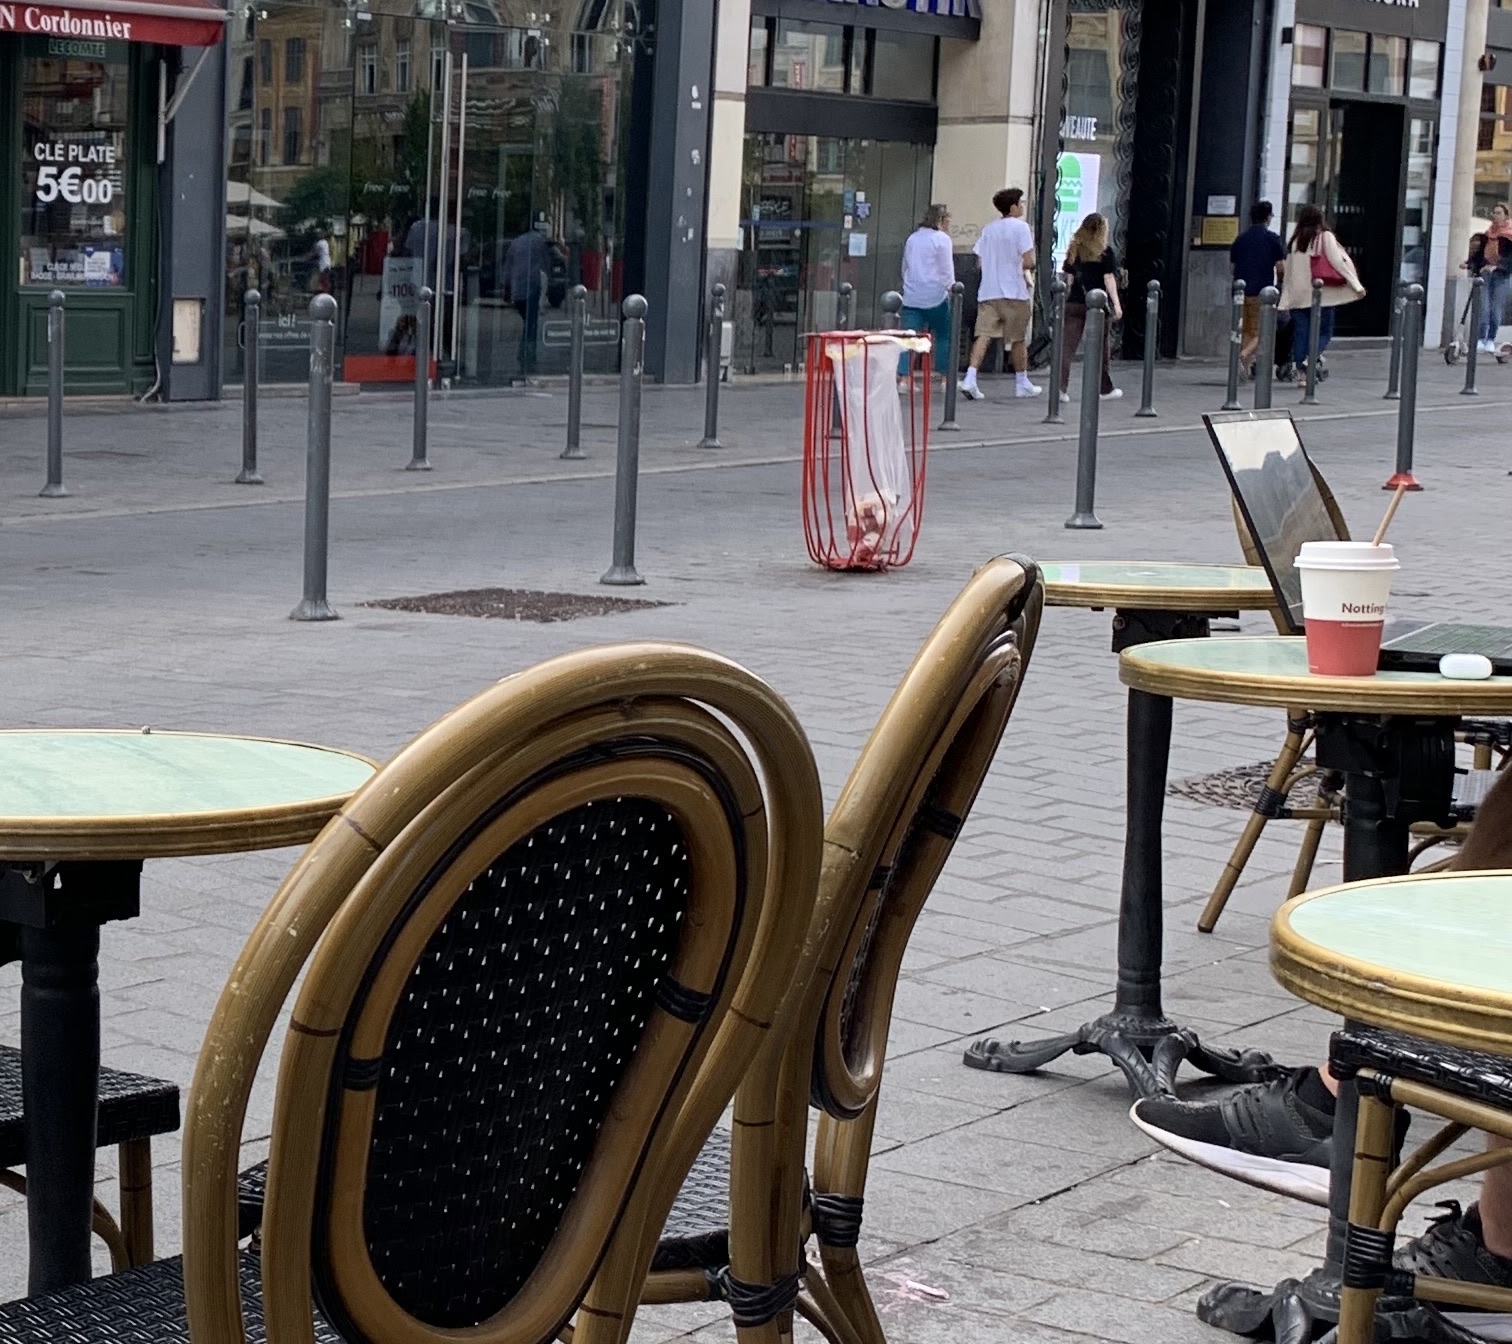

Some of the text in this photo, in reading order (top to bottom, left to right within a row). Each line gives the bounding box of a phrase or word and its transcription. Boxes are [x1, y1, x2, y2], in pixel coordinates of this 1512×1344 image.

[24, 5, 131, 40] Cordonnier
[48, 38, 106, 58] LECOMTE
[34, 140, 116, 163] CLÉ PLATE
[36, 166, 113, 204] 5€00
[1342, 603, 1384, 616] Notting
